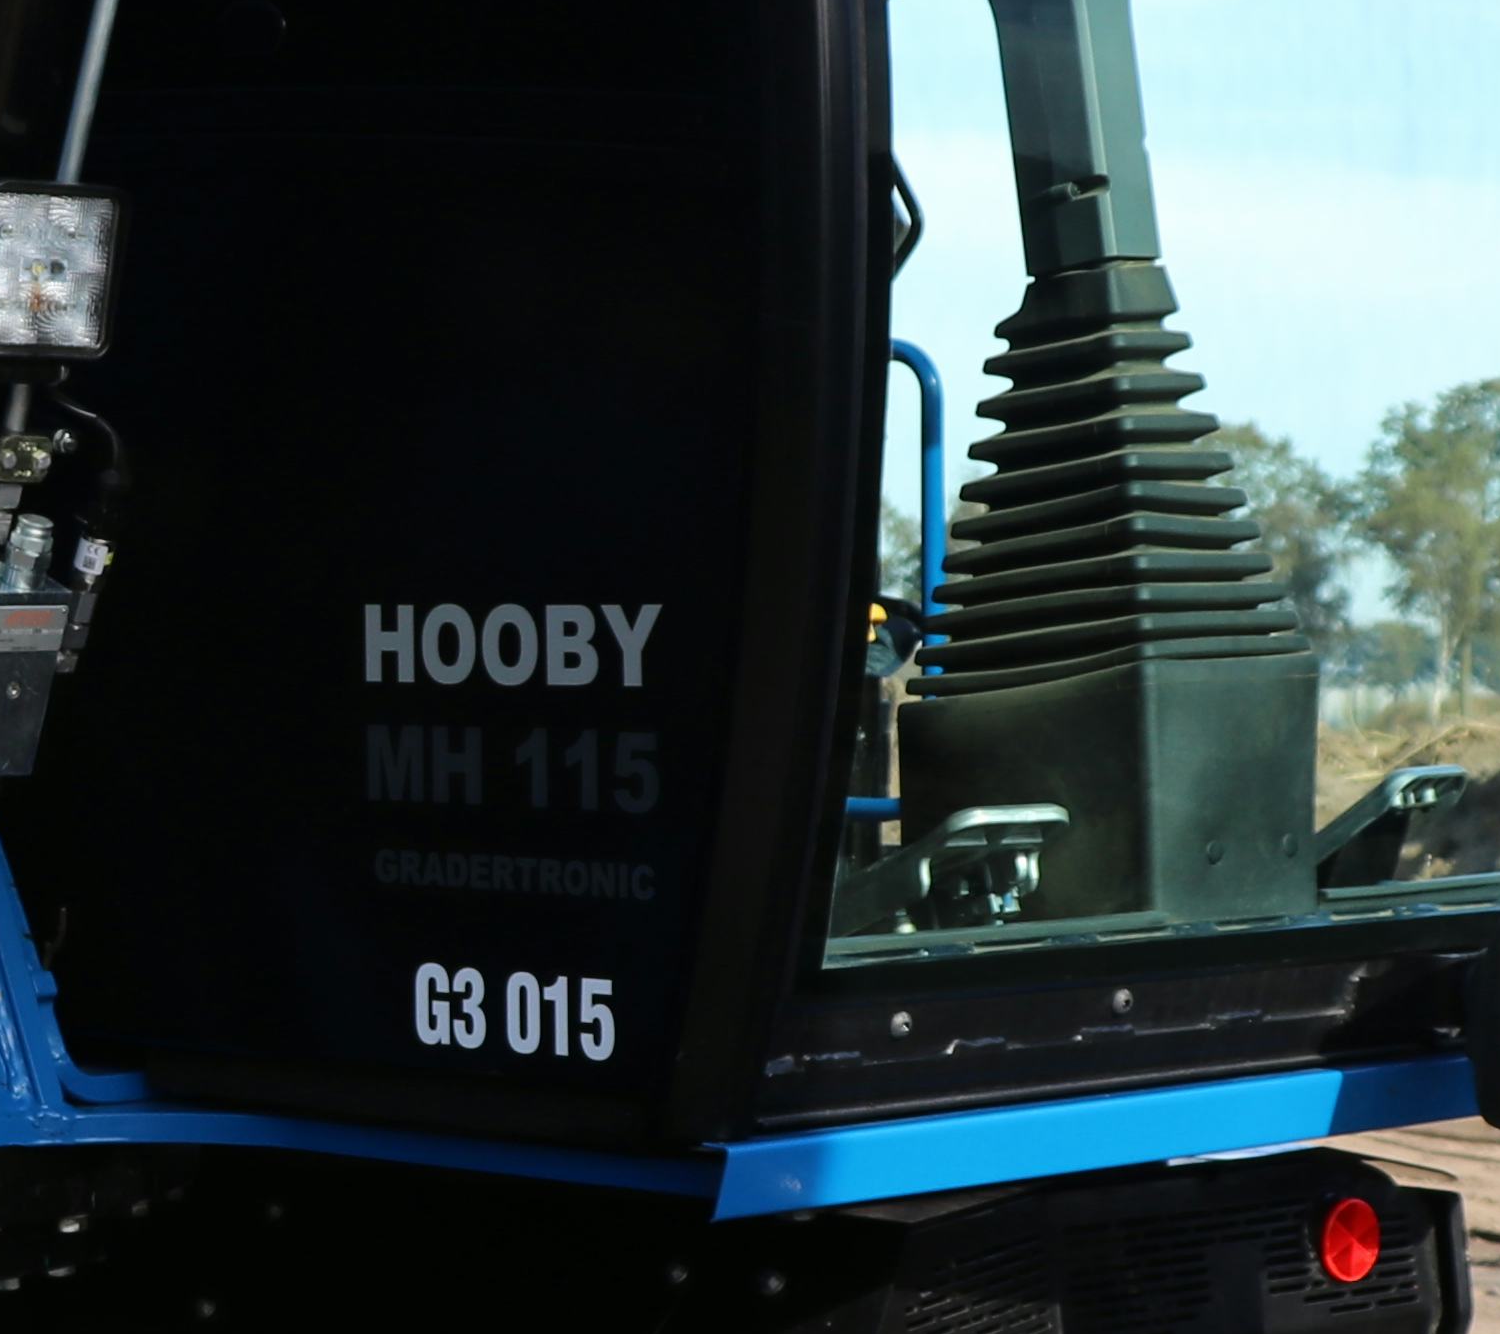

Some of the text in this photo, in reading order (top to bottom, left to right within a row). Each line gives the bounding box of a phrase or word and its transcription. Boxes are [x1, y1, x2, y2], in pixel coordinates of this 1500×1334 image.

[364, 603, 663, 687] HOOBY
[366, 724, 661, 814] MH 115
[375, 848, 657, 901] GRADERTRONIC
[413, 961, 616, 1063] G3 015
